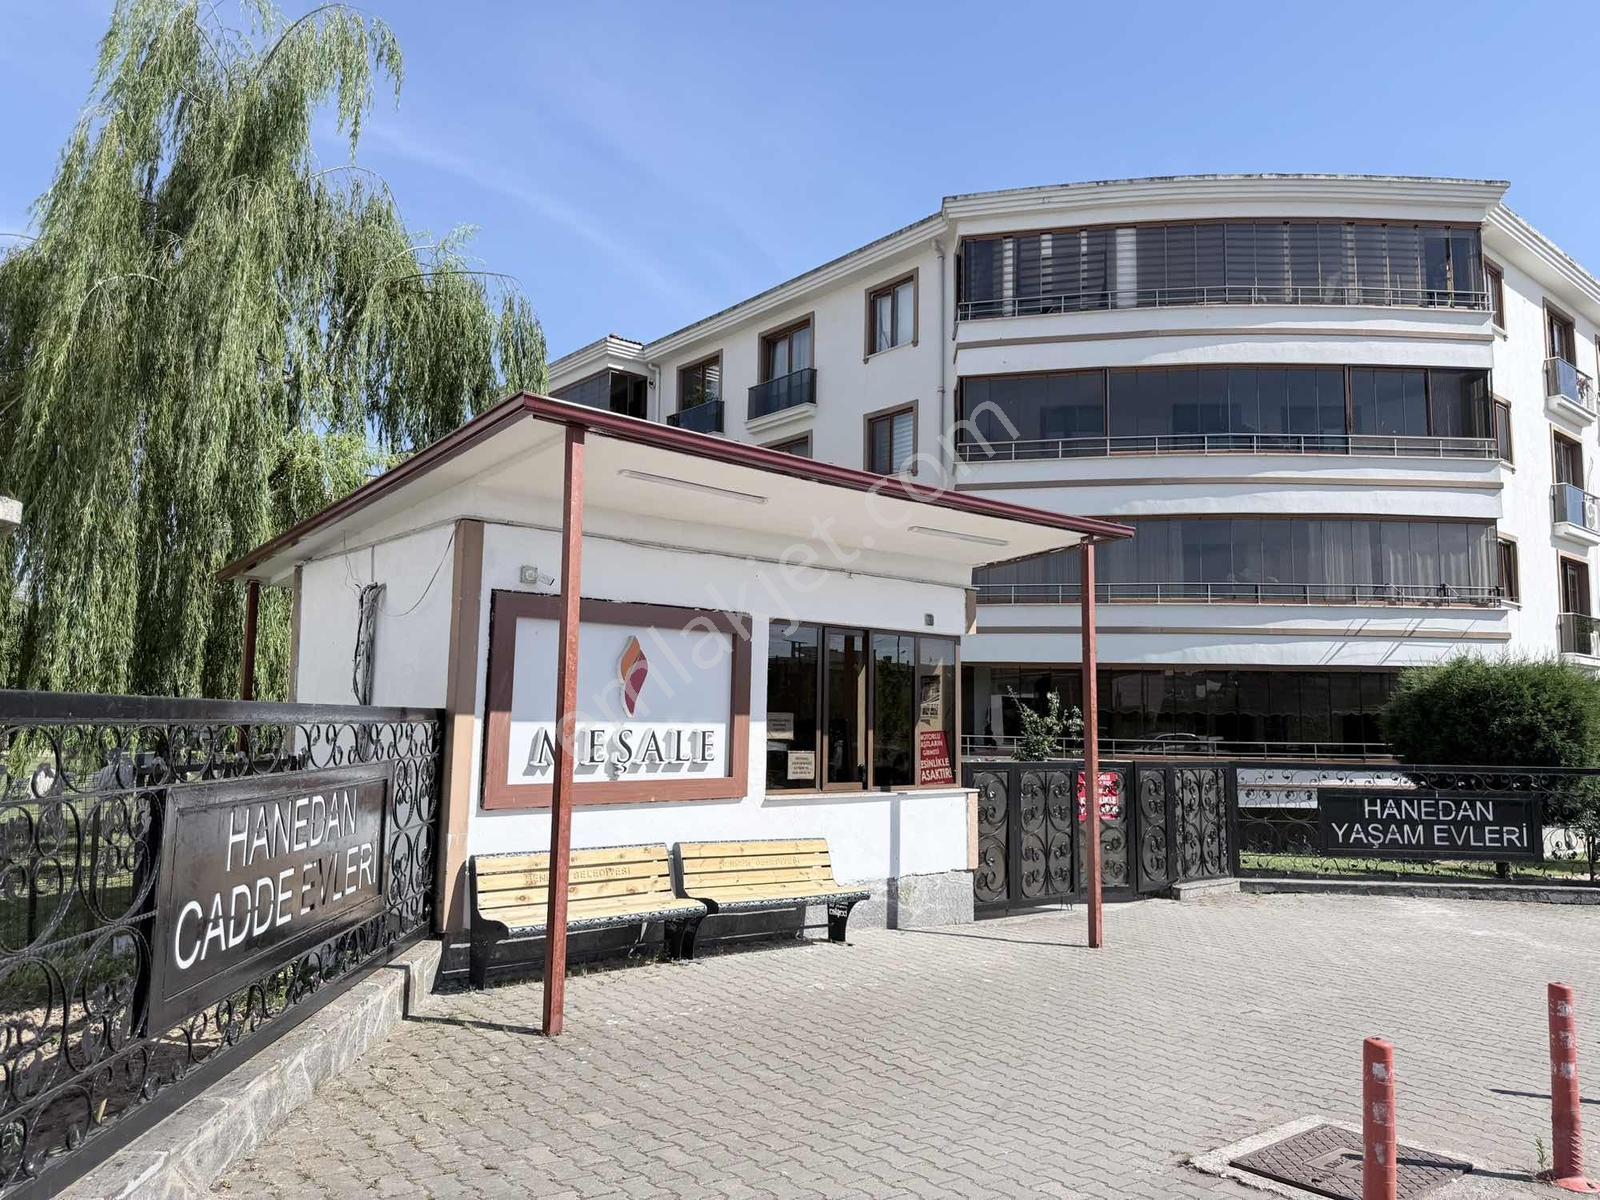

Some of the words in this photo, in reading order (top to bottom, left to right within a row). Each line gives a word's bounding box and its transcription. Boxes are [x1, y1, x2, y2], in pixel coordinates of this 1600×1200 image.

[920, 757, 950, 769] ESİNLİKLE
[1364, 799, 1494, 822] HANEDAN
[226, 789, 358, 872] HANEDAN
[1331, 823, 1424, 848] YAŞAM
[1434, 823, 1528, 848] EVLERİ
[174, 867, 295, 970] CADDE
